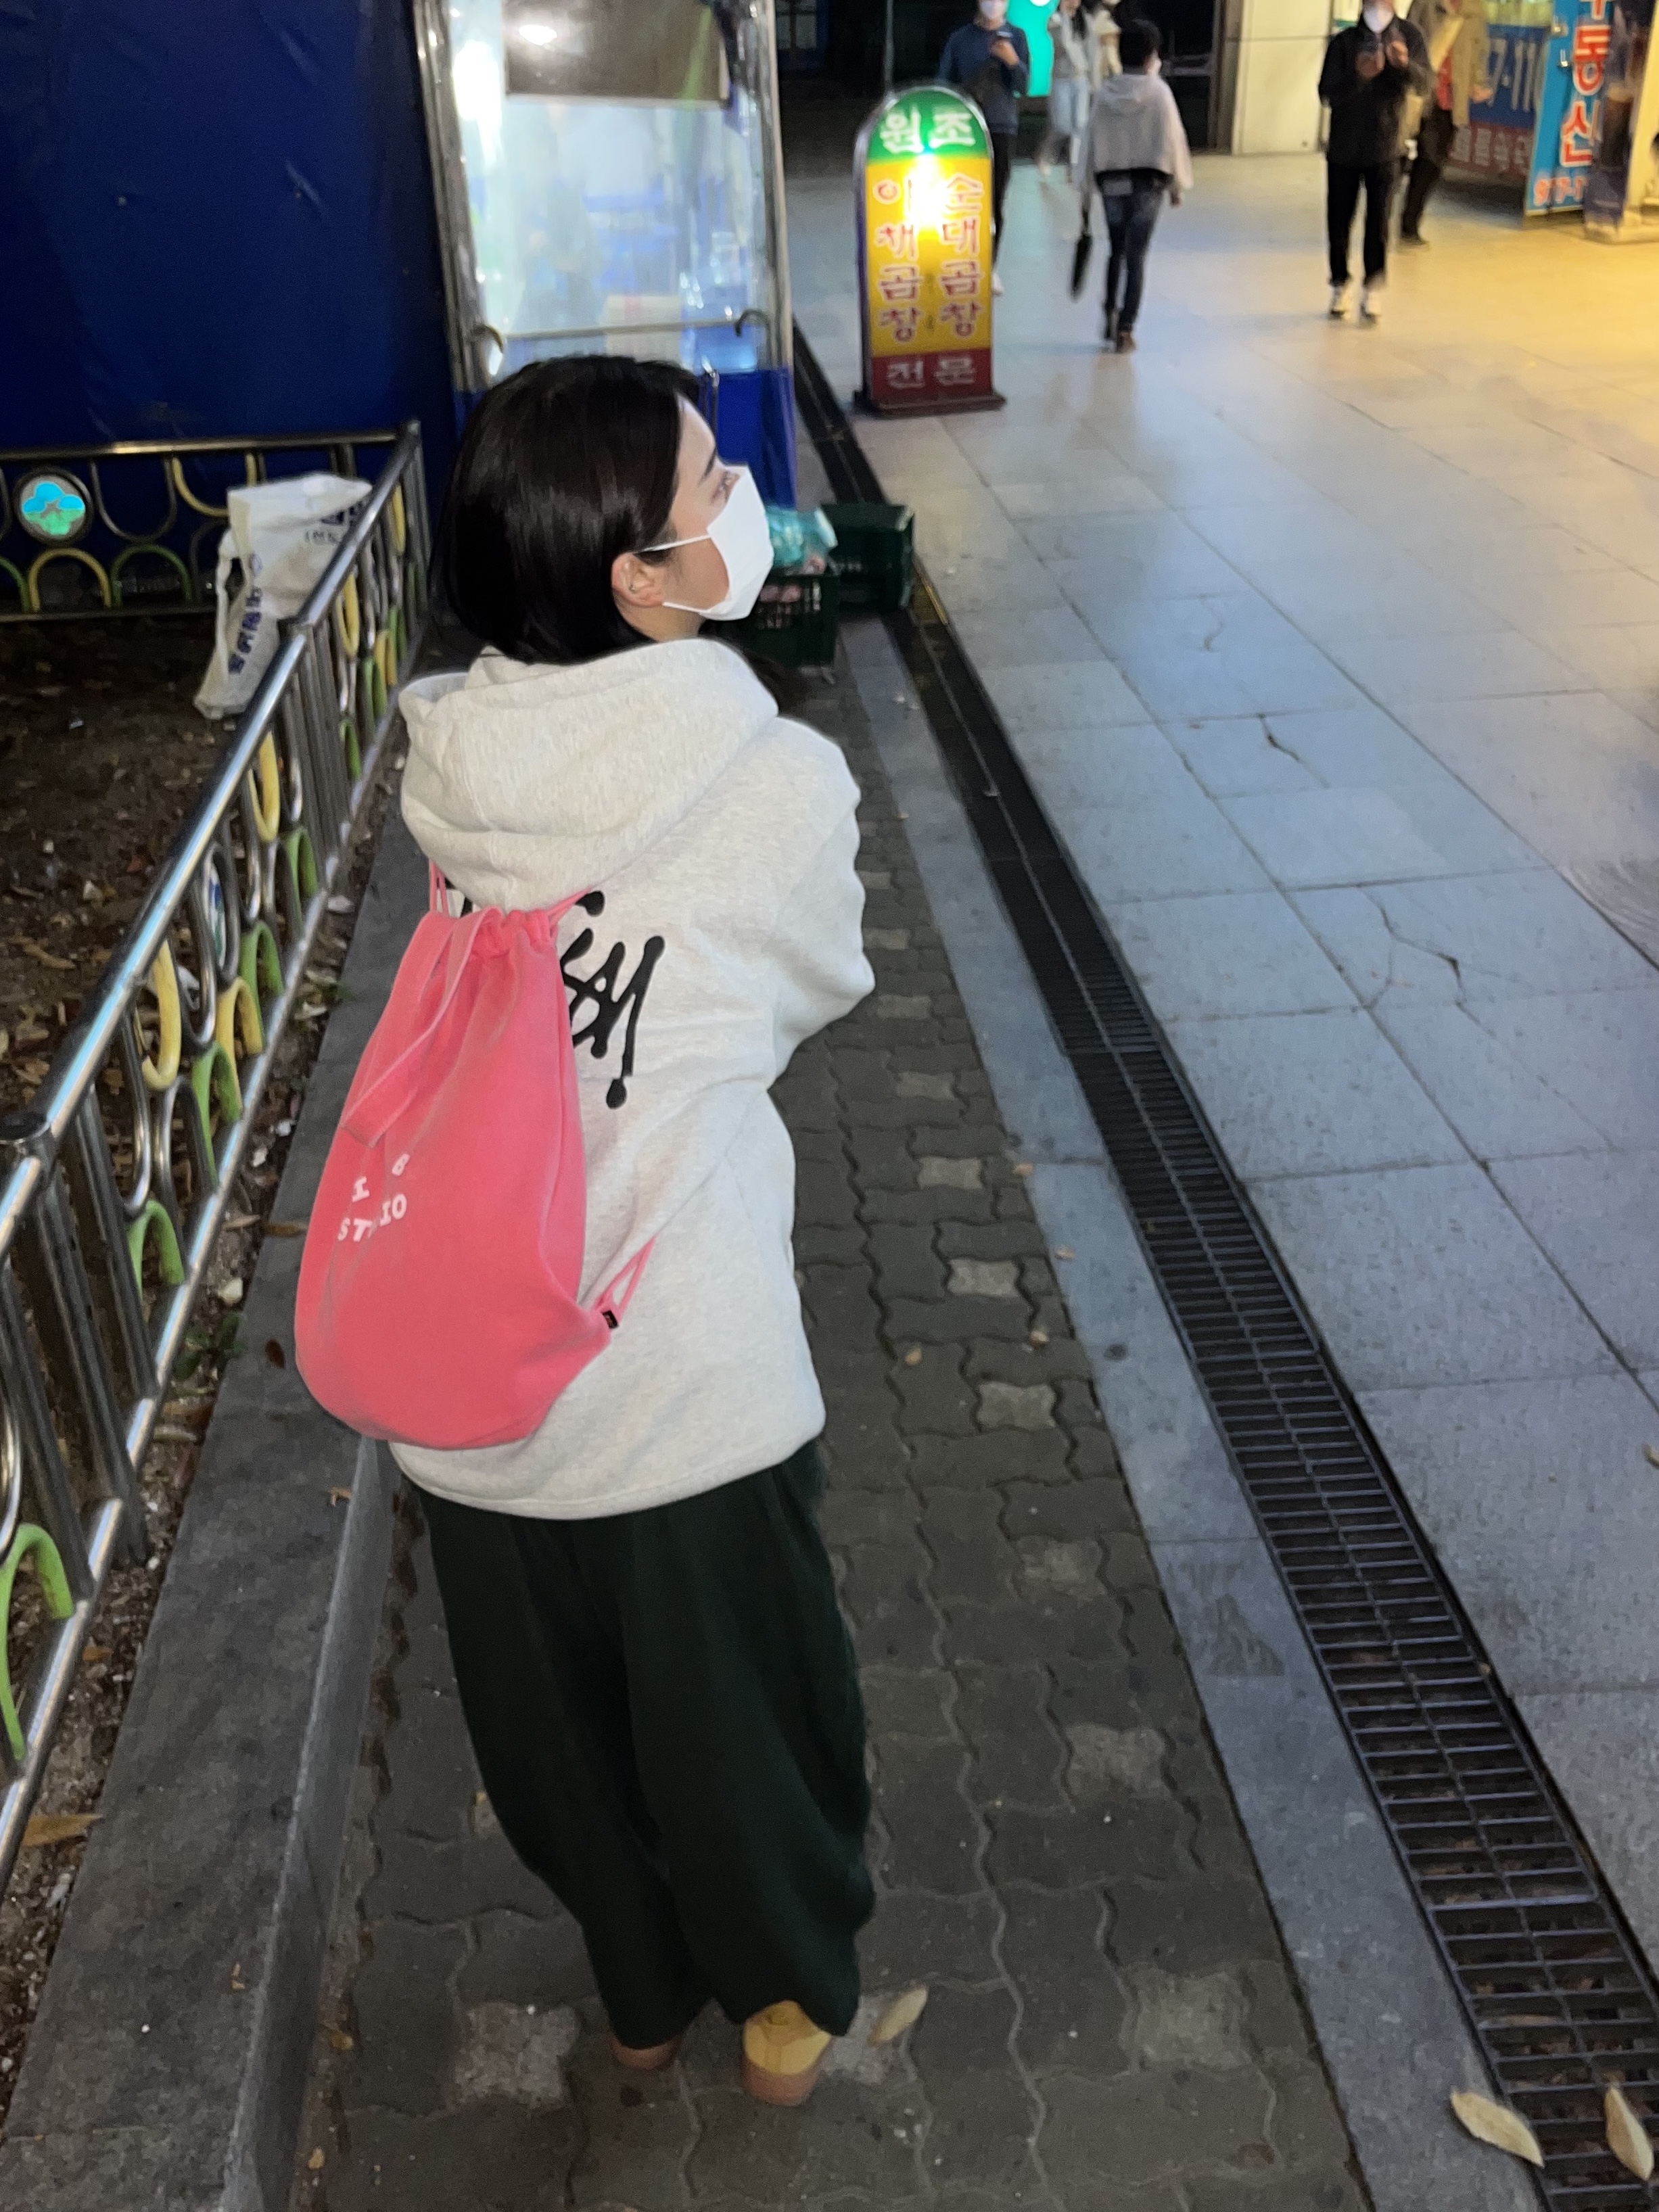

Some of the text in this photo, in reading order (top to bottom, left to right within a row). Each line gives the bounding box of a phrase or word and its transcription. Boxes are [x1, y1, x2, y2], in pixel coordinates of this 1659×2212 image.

[879, 105, 976, 154] 원조
[1560, 0, 1612, 167] 동산
[938, 172, 984, 338] 순대곱창
